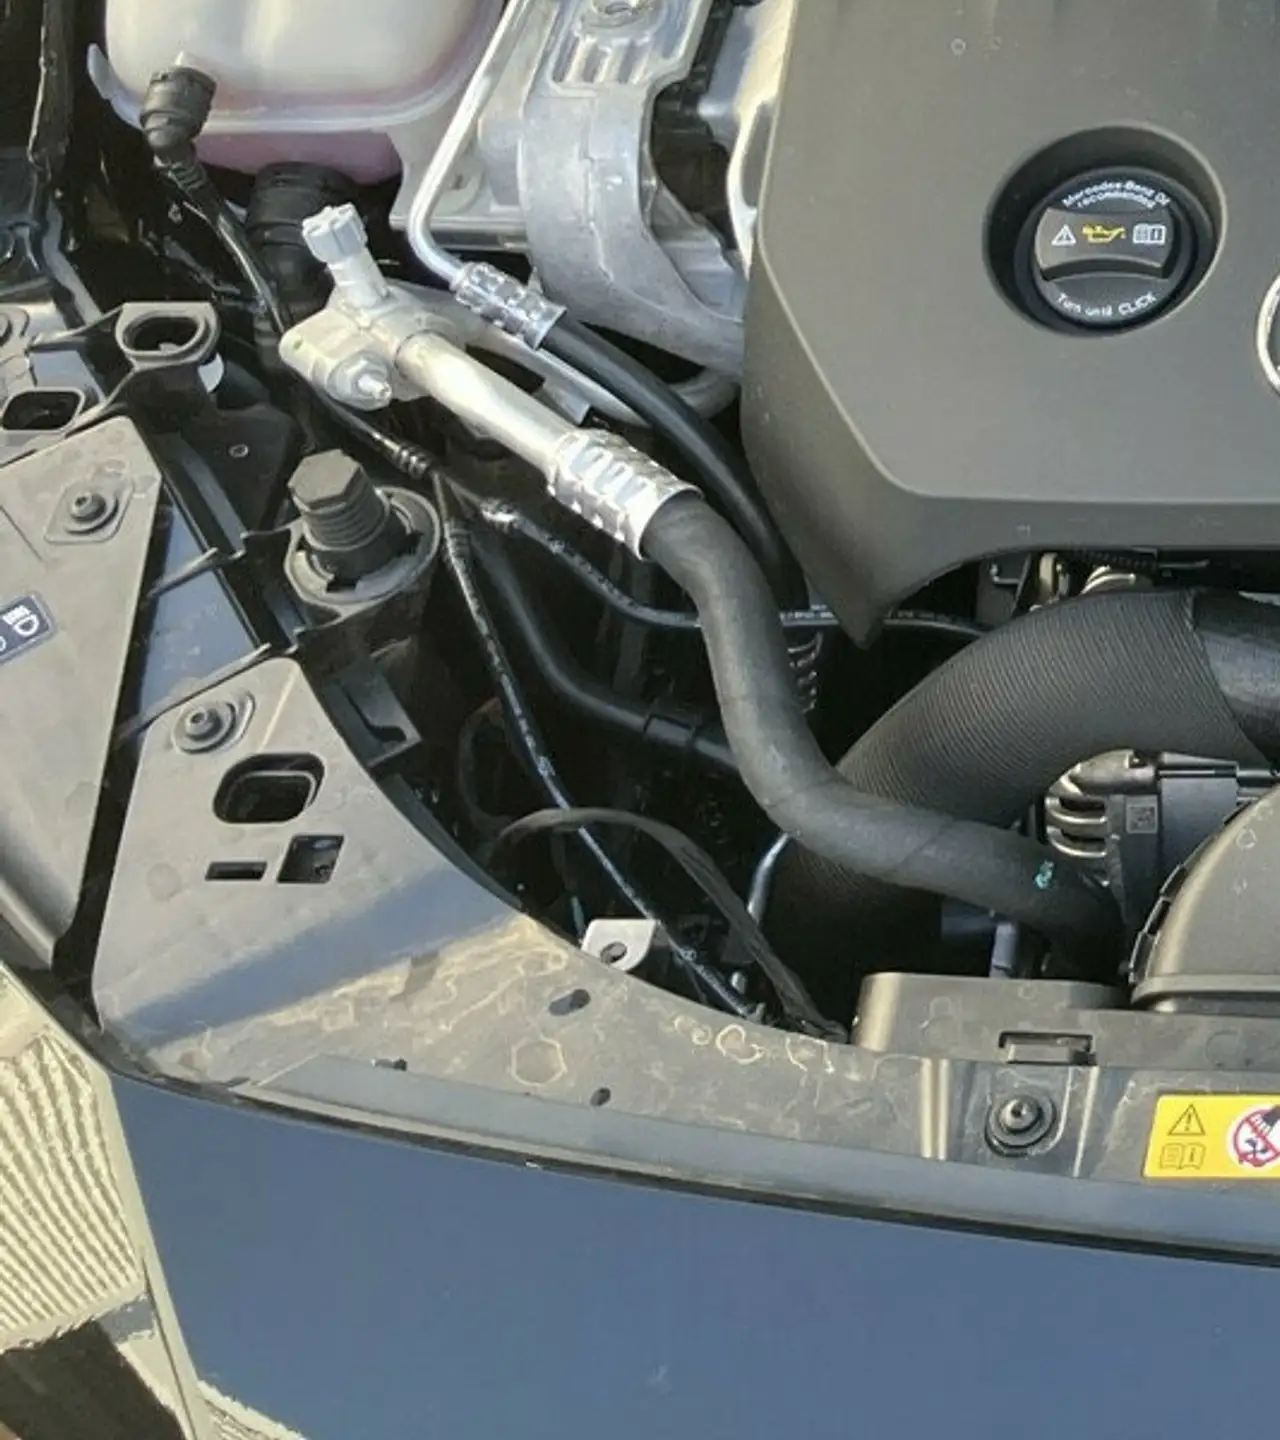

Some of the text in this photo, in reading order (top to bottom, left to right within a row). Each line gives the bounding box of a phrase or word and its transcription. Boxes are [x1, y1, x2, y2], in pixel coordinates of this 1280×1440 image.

[1057, 292, 1157, 317] Turn until CLICK
